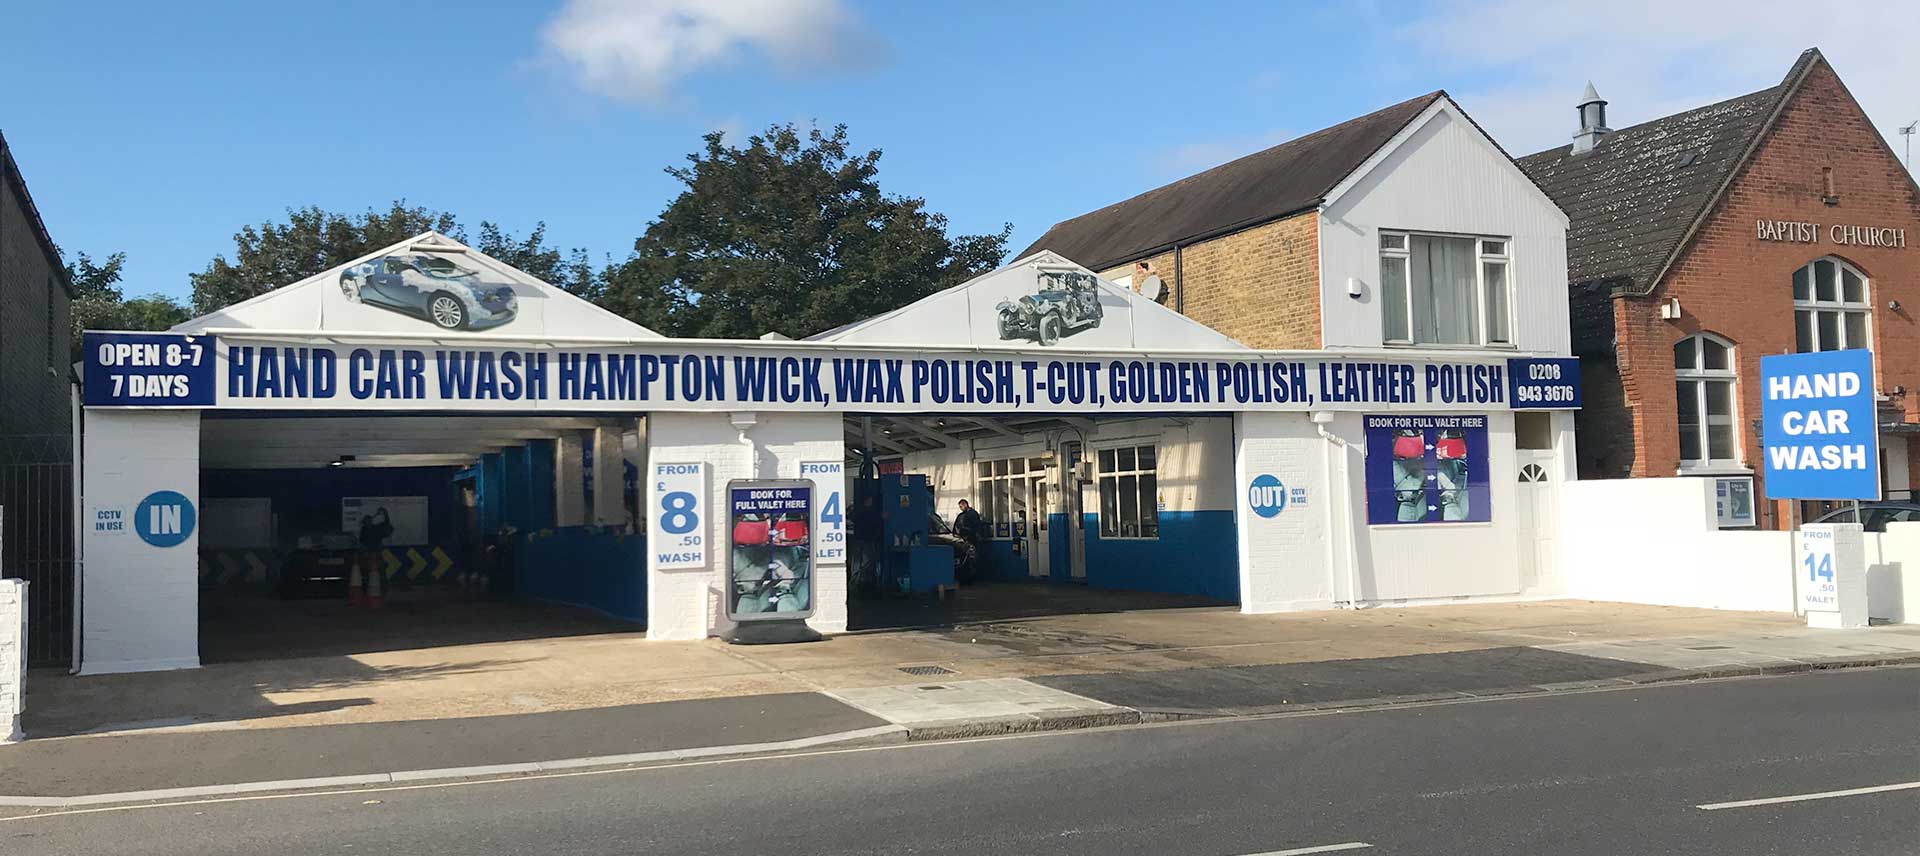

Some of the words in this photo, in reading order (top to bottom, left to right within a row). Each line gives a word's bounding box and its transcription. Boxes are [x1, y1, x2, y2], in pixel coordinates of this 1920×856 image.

[1757, 220, 1820, 243] BAPTIST
[1830, 225, 1905, 248] CHURCH
[99, 343, 161, 367] OPEN
[166, 344, 203, 367] 8-7
[227, 346, 338, 399] HAND
[349, 348, 427, 400] CAR
[436, 350, 548, 400] WASH
[558, 352, 726, 402] HAMPTON
[832, 357, 905, 404] WAX
[1108, 360, 1210, 404] GOLDEN
[1216, 361, 1314, 407] POLISH,
[1318, 362, 1416, 404] LEATHER
[1425, 364, 1504, 405] POLISH
[1528, 363, 1561, 381] 0208
[110, 374, 124, 398] 7
[128, 374, 190, 398] DAYS
[1518, 385, 1543, 402] 943
[1544, 385, 1574, 402] 3676
[1769, 372, 1860, 400] HAND
[1369, 417, 1394, 428] BOOK
[1395, 417, 1412, 428] FOR
[1413, 418, 1433, 428] FULL
[1435, 418, 1460, 428] VALET
[1462, 418, 1483, 428] HERE
[1782, 409, 1850, 435] CAR
[1769, 444, 1866, 470] WASH
[657, 465, 699, 475] FROM
[801, 464, 841, 473] FROM
[657, 482, 666, 491] £
[751, 490, 774, 499] BOOK
[775, 490, 792, 499] FOR
[735, 501, 757, 510] FULL
[758, 501, 783, 510] VALET
[785, 500, 806, 509] HERE
[1250, 486, 1283, 508] OUT
[97, 510, 121, 520] CCTV
[150, 504, 181, 534] IN
[660, 491, 699, 534] 8
[820, 491, 843, 530] 4
[95, 521, 105, 531] IN
[106, 521, 123, 531] USE
[658, 552, 702, 563] WASH
[1804, 553, 1833, 582] 14
[1806, 596, 1835, 604] VALET
